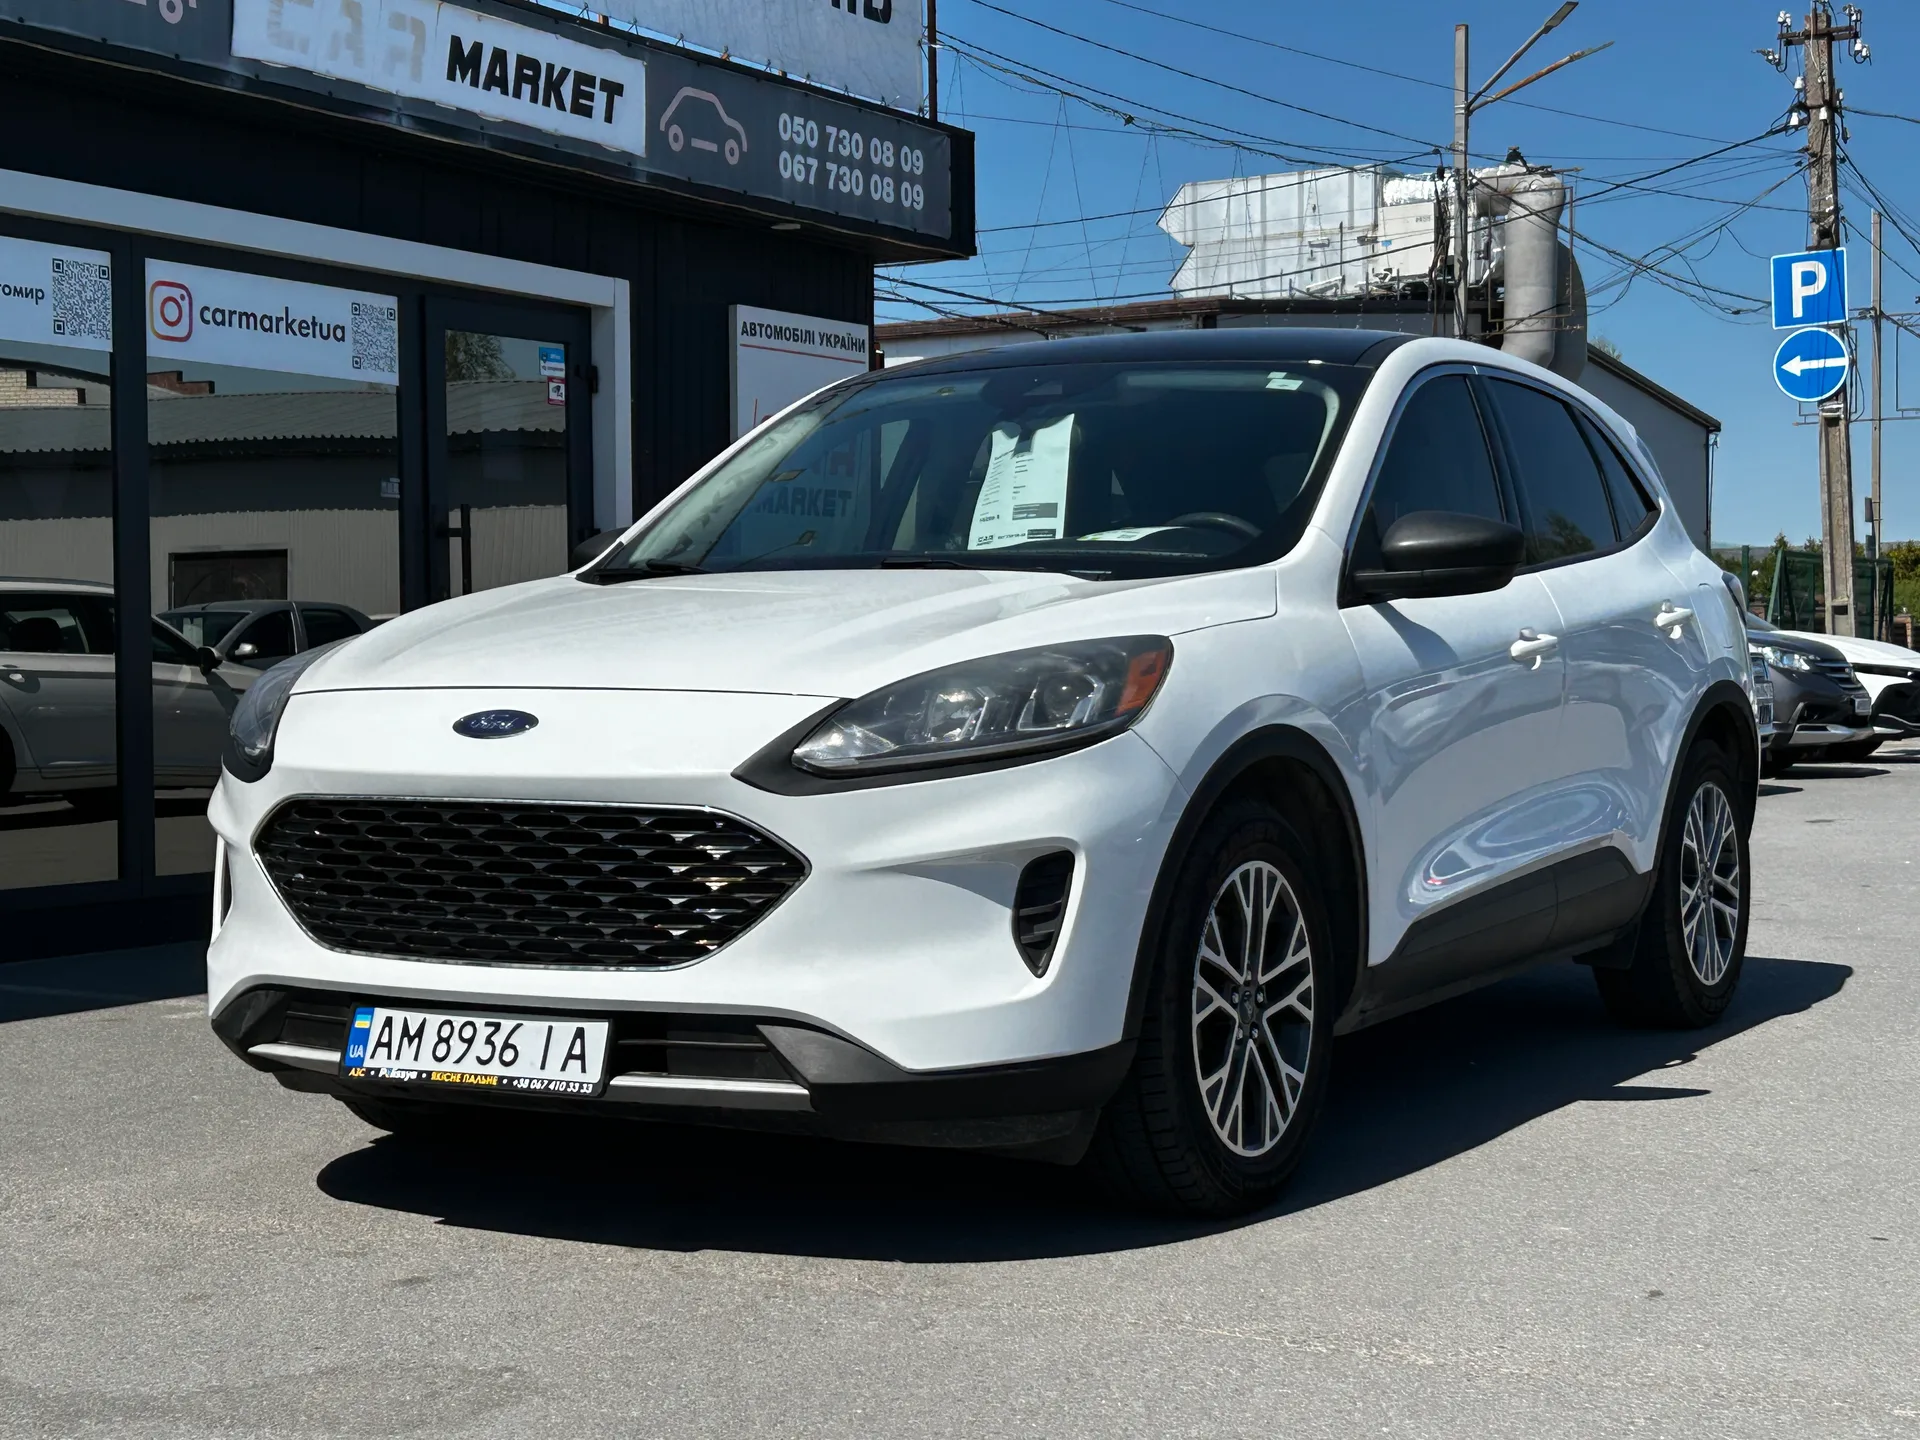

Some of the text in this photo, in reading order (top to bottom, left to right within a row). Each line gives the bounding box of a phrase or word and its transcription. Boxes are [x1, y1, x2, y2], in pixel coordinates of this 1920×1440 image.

[446, 34, 625, 125] MARKET
[778, 112, 924, 175] 050 730 08 09
[778, 150, 924, 211] 067 730 08 09
[1791, 260, 1827, 319] P
[199, 300, 346, 343] carmarketua
[740, 321, 866, 353] АВТОМОБІЛІ УКРАЇНИ
[349, 1043, 364, 1058] UA
[369, 1015, 587, 1073] AM 8936 IA
[348, 1067, 367, 1077] АЗС
[548, 1080, 566, 1091] 410
